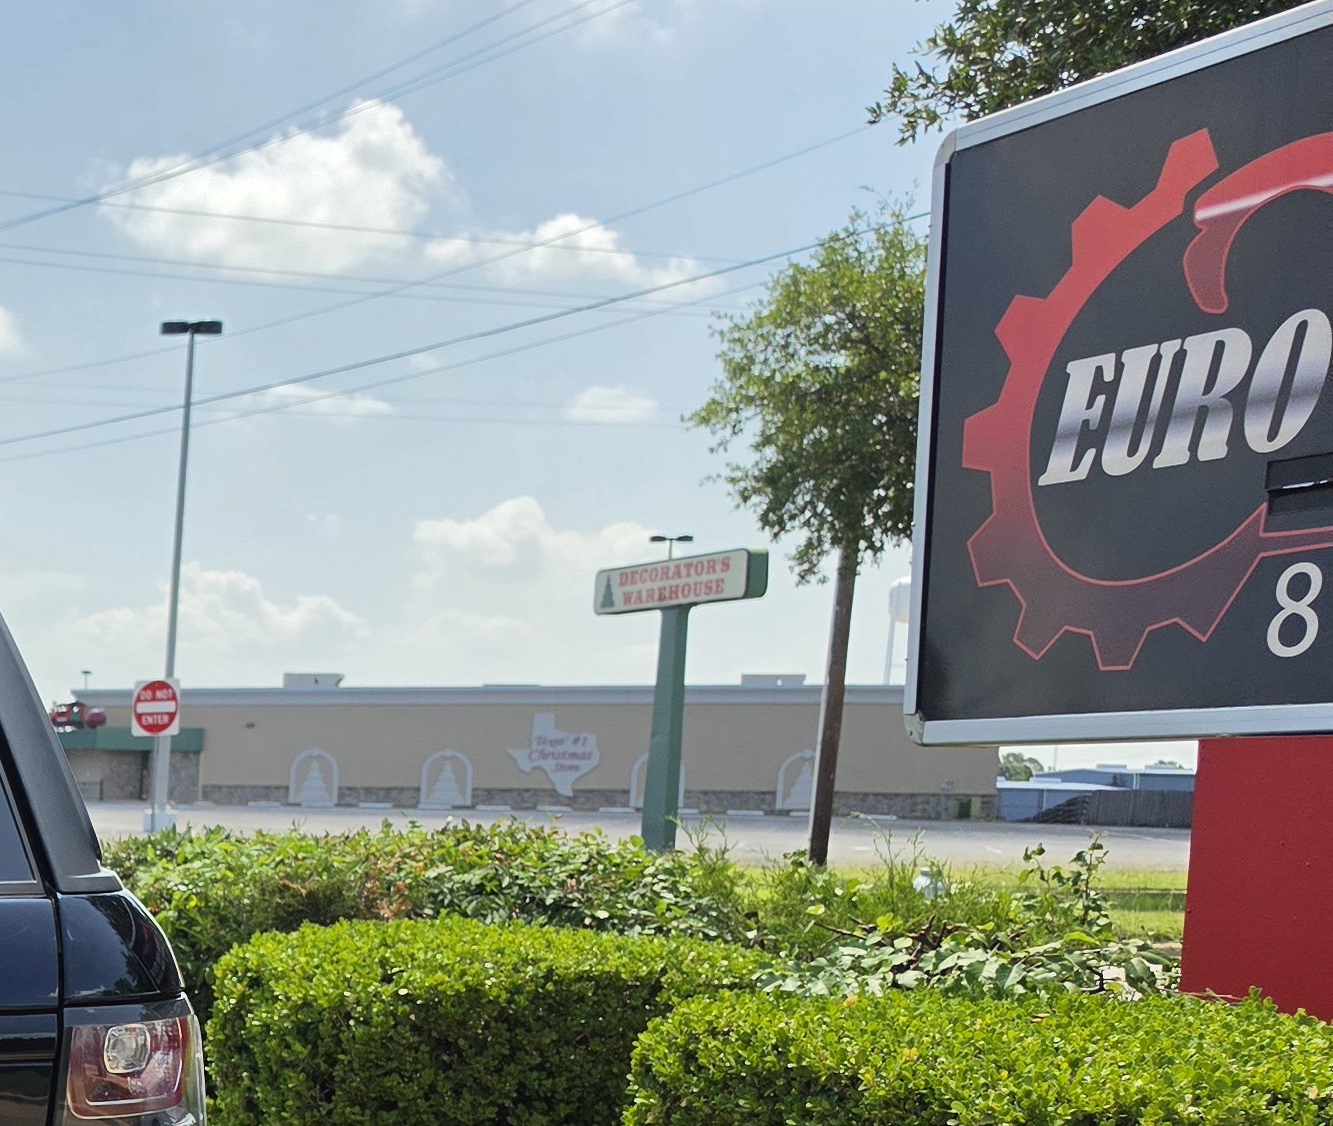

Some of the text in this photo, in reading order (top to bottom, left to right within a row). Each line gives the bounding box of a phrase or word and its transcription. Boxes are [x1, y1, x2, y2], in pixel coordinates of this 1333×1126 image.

[1038, 308, 1333, 486] EURO
[618, 555, 731, 587] DECORATOR'S
[622, 578, 725, 606] WAREHOUSE
[139, 688, 173, 700] DO NOT
[142, 713, 169, 726] ENTER
[528, 748, 593, 762] Christmas
